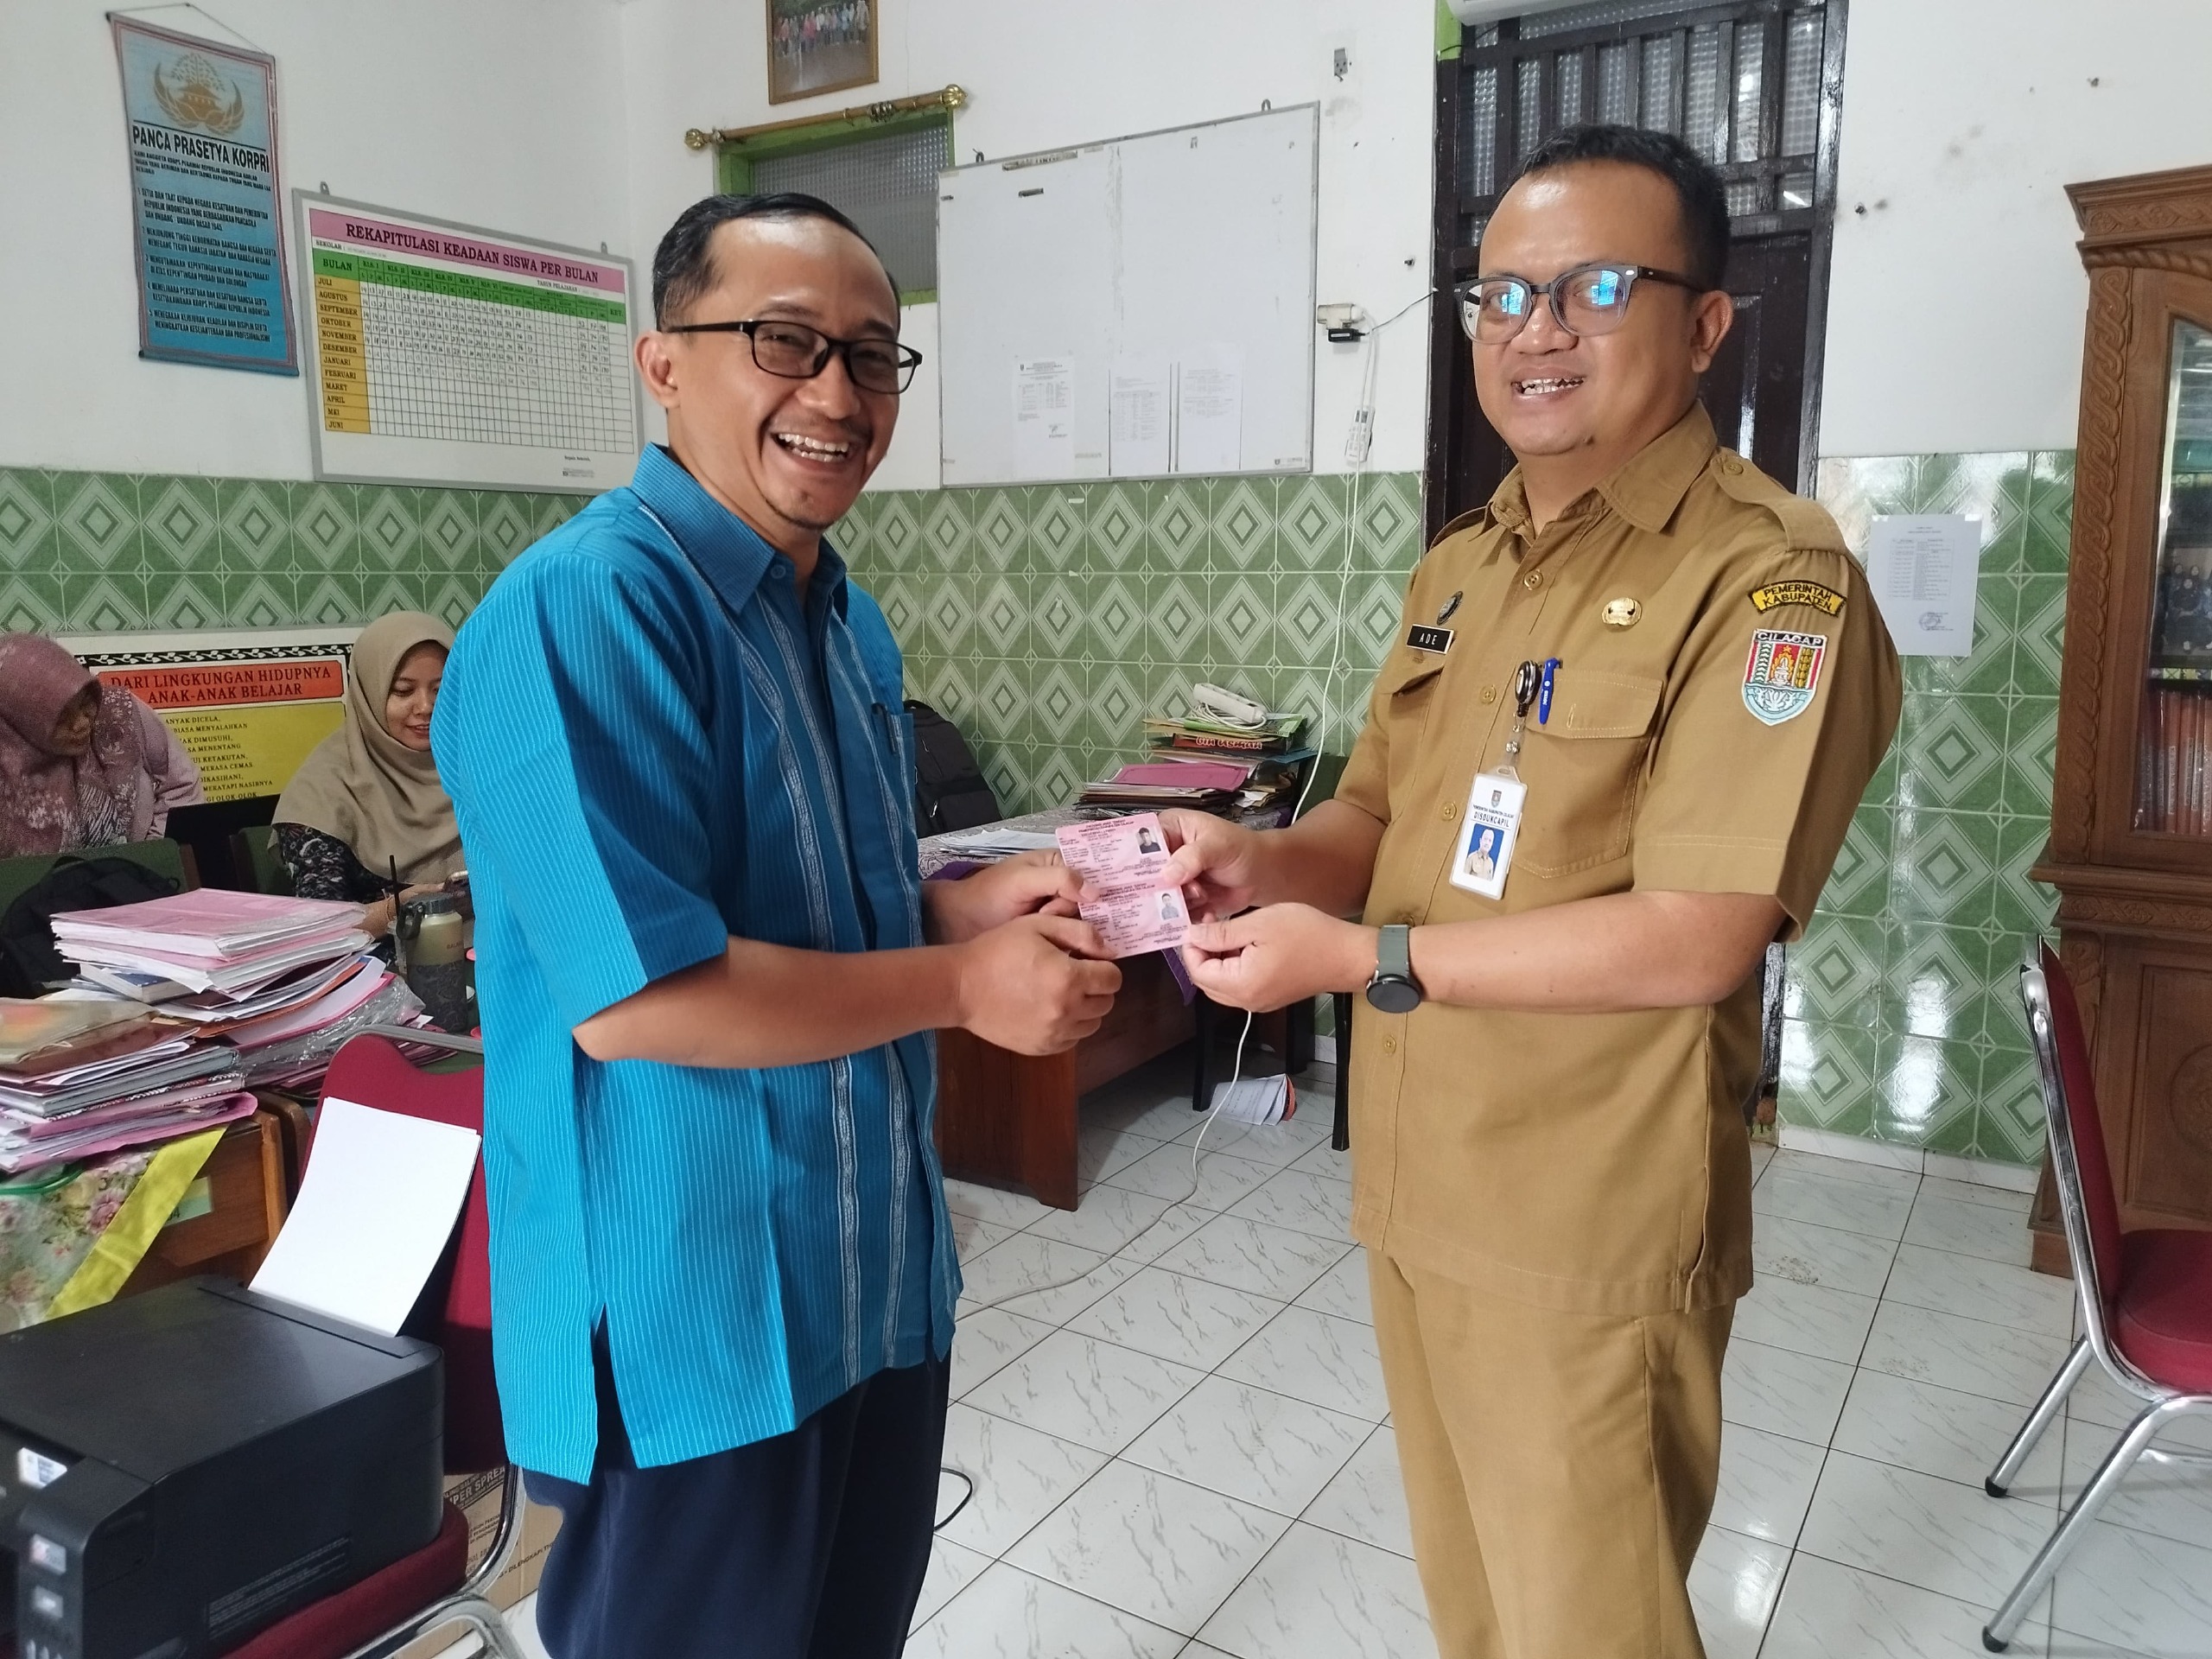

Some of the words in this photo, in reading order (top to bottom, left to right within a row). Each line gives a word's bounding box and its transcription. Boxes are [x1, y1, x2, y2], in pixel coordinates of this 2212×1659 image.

[132, 124, 172, 152] PANCA
[174, 134, 230, 164] PRASETYA
[232, 147, 270, 173] KORPRI
[315, 239, 342, 251] SEKOLAH
[346, 223, 440, 253] REKAPITULASI
[443, 242, 499, 264] KEADAAN
[503, 254, 537, 271] SISWA
[541, 261, 562, 276] PER
[565, 267, 599, 283] BULAN
[323, 258, 352, 271] BULAN
[318, 277, 333, 286] JULI
[319, 290, 348, 302] AGUSTUS
[320, 304, 358, 315] SEPTEMBER
[321, 317, 352, 327] OKTOBER
[321, 329, 357, 341] NOVEMBER
[322, 343, 358, 353] DESEMBER
[323, 356, 351, 365] JANUARI
[325, 370, 356, 379] FEBRUARI
[326, 382, 347, 391] MARET
[328, 421, 343, 429] JUNI
[1764, 583, 1832, 601] PEMERINTAH
[1763, 592, 1832, 611] KABUPATEN
[1419, 632, 1438, 645] ADE
[1758, 632, 1821, 646] CILACAP
[111, 676, 149, 689] DARI
[153, 671, 254, 688] LINGKUNGAN
[258, 666, 331, 682] HIDUPNYA
[148, 686, 237, 703] ANAK-ANAK
[241, 683, 302, 698] BELAJAR
[196, 723, 248, 732] MENYALAHKAN
[198, 743, 241, 752] MENENTANG
[203, 784, 238, 792] MERATAPI
[216, 792, 257, 801] OLOK-OLOK
[1473, 811, 1510, 827] DISDUKCAPIL
[474, 1466, 505, 1491] SPREA
